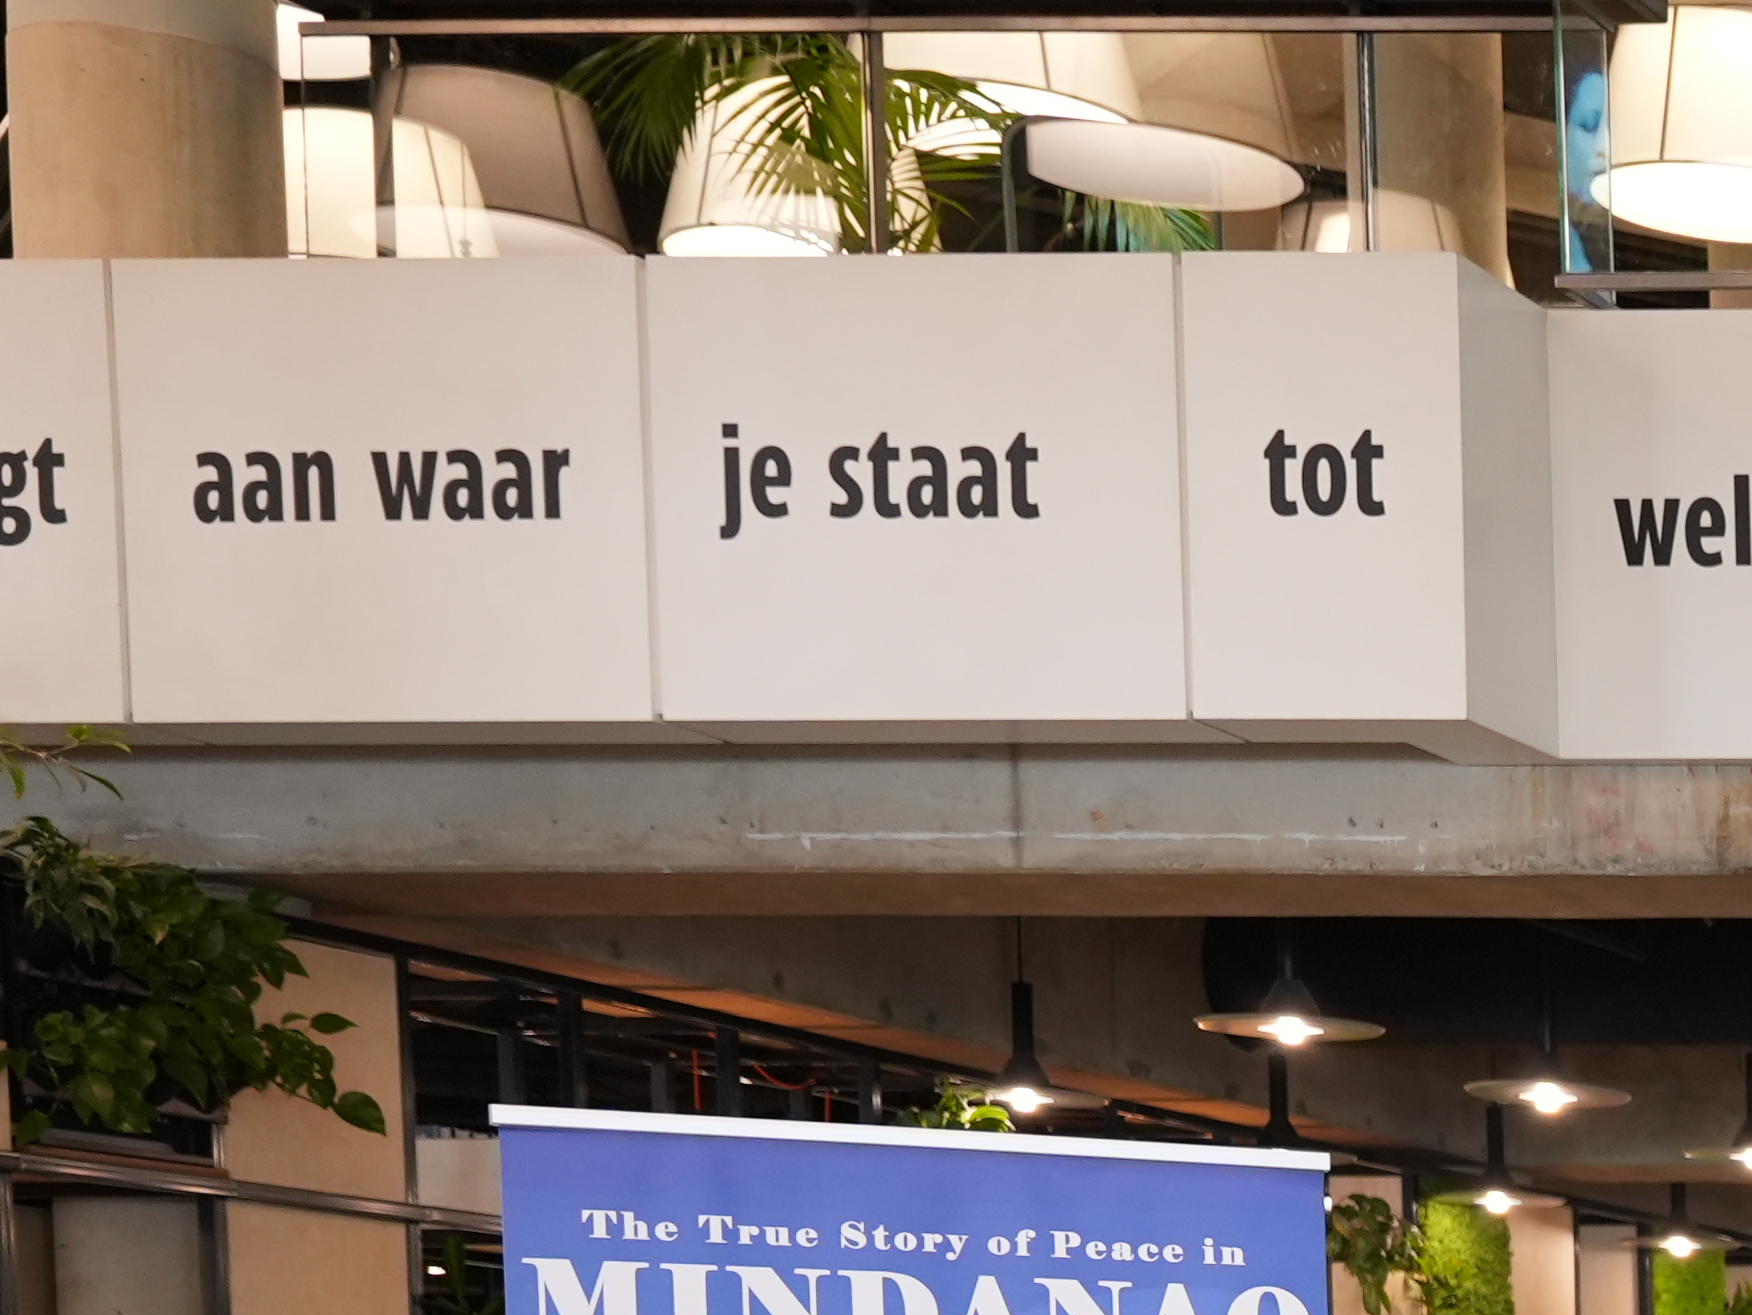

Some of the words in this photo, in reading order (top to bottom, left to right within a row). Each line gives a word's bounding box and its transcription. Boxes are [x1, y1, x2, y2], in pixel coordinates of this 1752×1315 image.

[194, 451, 336, 523] aan
[371, 449, 569, 521] waar
[720, 424, 791, 539] je
[829, 432, 1039, 519] staat
[1264, 430, 1385, 516] tot
[582, 1210, 678, 1241] The
[698, 1215, 818, 1247] True
[841, 1221, 968, 1260] Story
[988, 1229, 1036, 1256] of
[1050, 1231, 1183, 1262] Peace
[1202, 1238, 1245, 1265] in
